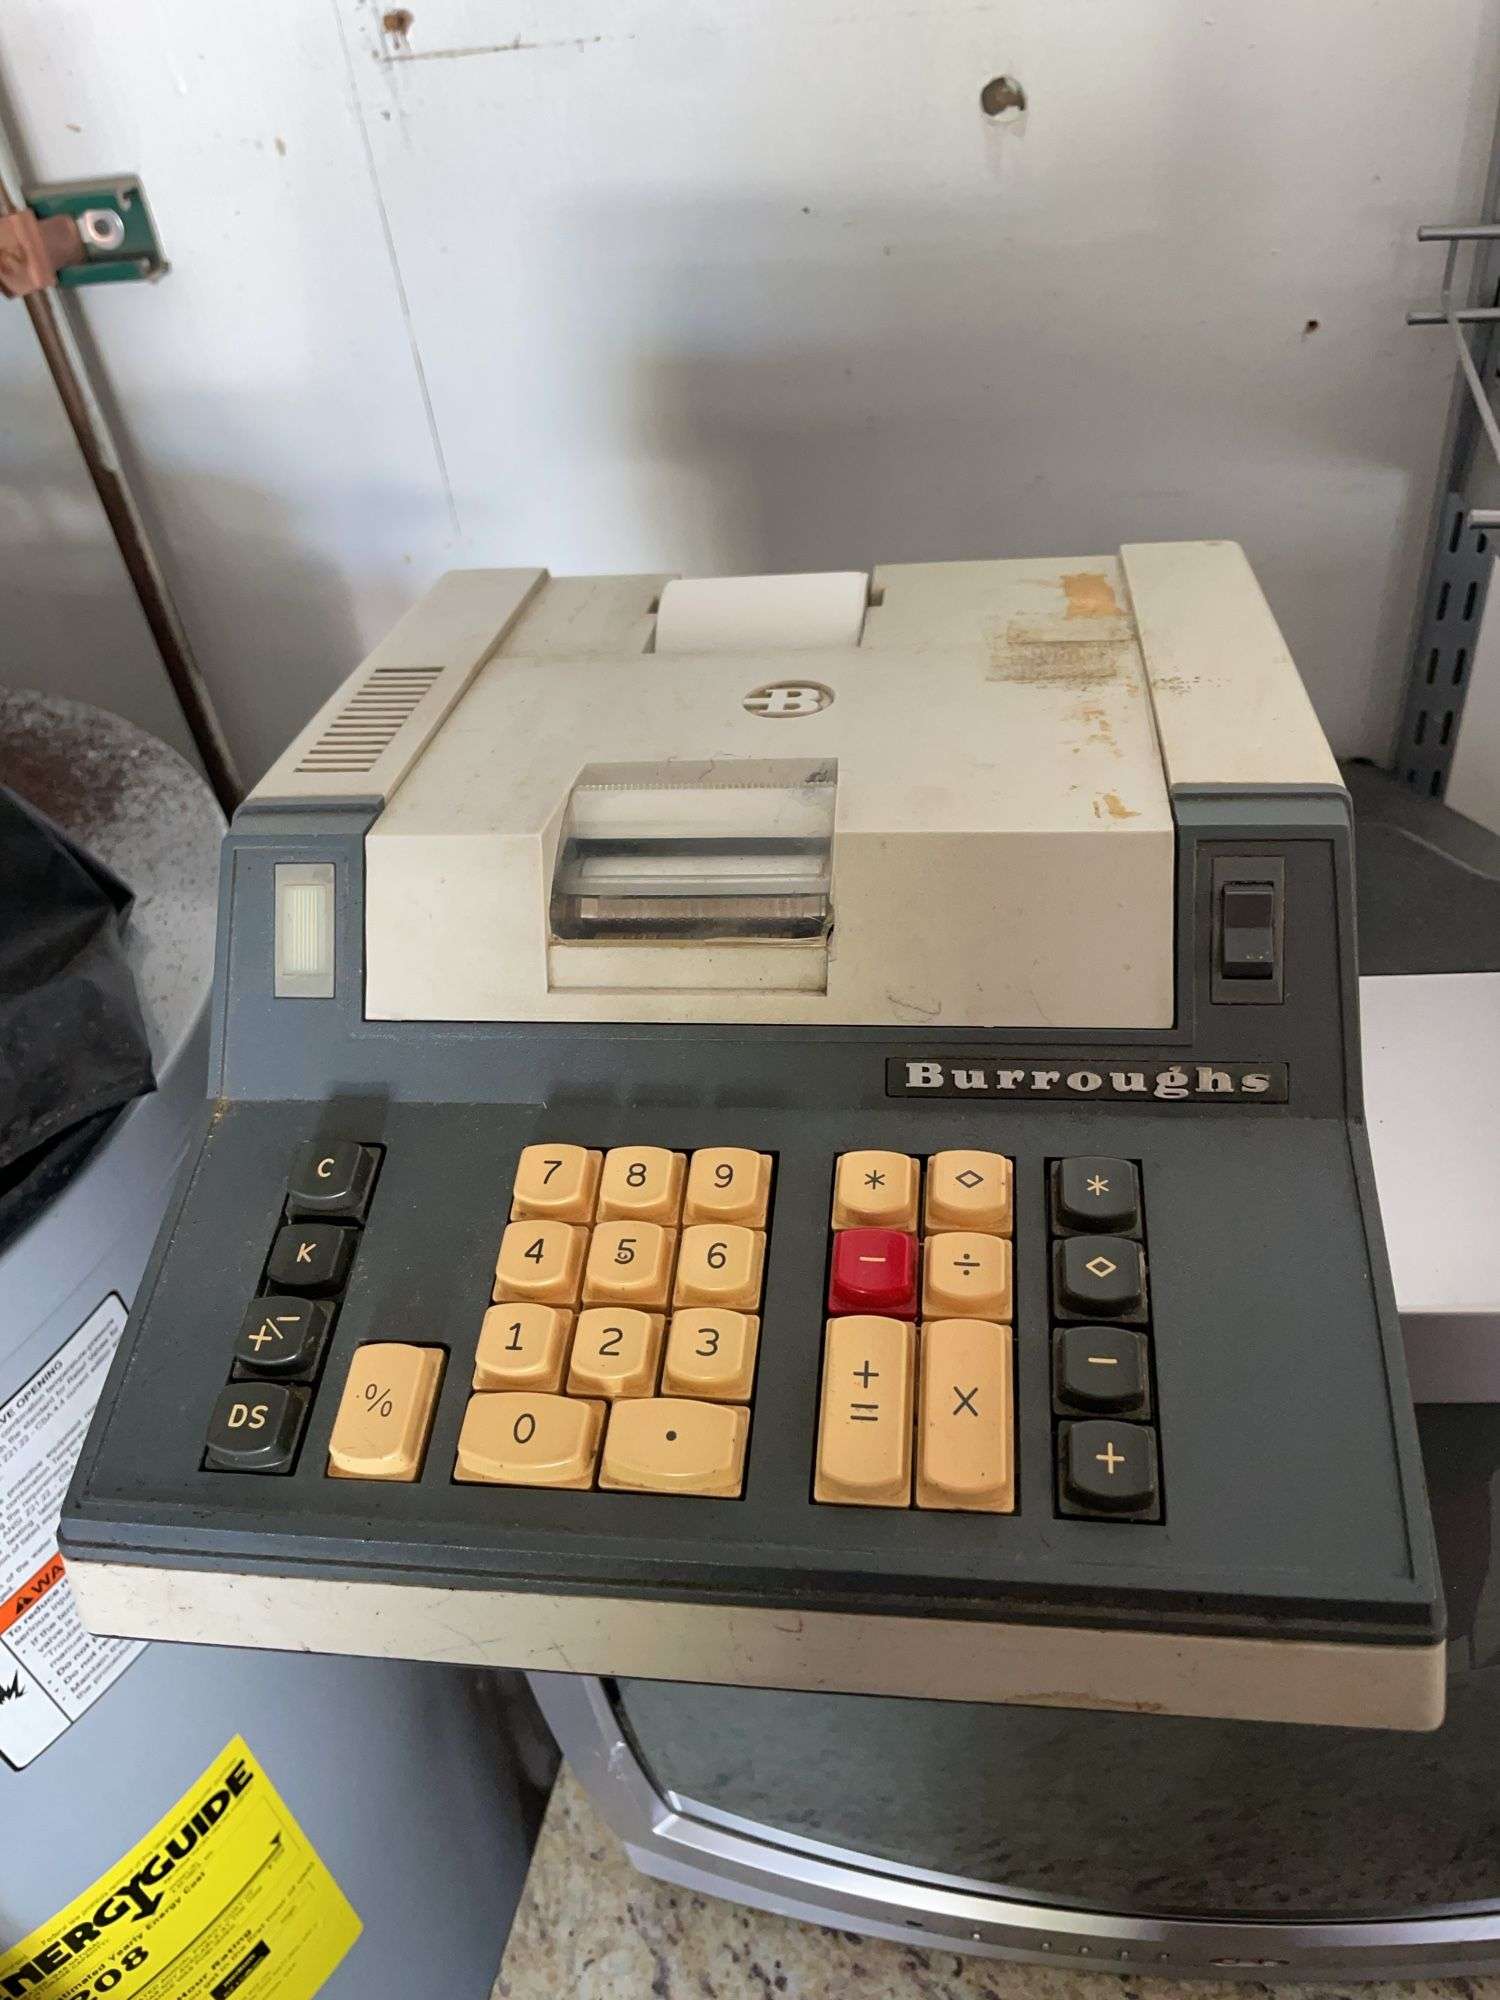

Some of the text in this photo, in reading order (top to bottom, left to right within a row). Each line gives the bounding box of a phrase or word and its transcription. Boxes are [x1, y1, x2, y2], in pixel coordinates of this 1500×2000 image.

[905, 1062, 1271, 1099] Burroughs
[318, 1157, 335, 1178] C
[542, 1159, 562, 1185] 7
[626, 1162, 647, 1187] 8
[713, 1163, 734, 1188] 9
[296, 1242, 317, 1263] K
[524, 1238, 545, 1265] 4
[613, 1238, 637, 1265] 5
[706, 1242, 727, 1269] 6
[504, 1322, 524, 1352] 1
[598, 1327, 624, 1356] 2
[695, 1328, 720, 1357] 3
[17, 1360, 63, 1409] OPENING
[364, 1383, 393, 1418] %
[227, 1403, 270, 1430] DS
[513, 1413, 536, 1444] 0
[9, 1625, 22, 1637] To
[57, 1660, 72, 1676] Do
[73, 1642, 90, 1661] not
[64, 1669, 79, 1685] Do
[80, 1651, 97, 1668] not
[0, 1759, 254, 2000] NERGYGUIDE
[108, 1932, 144, 1962] Yearly
[145, 1896, 182, 1931] Energy
[183, 1871, 206, 1894] Cost
[211, 1929, 252, 1971] Rating
